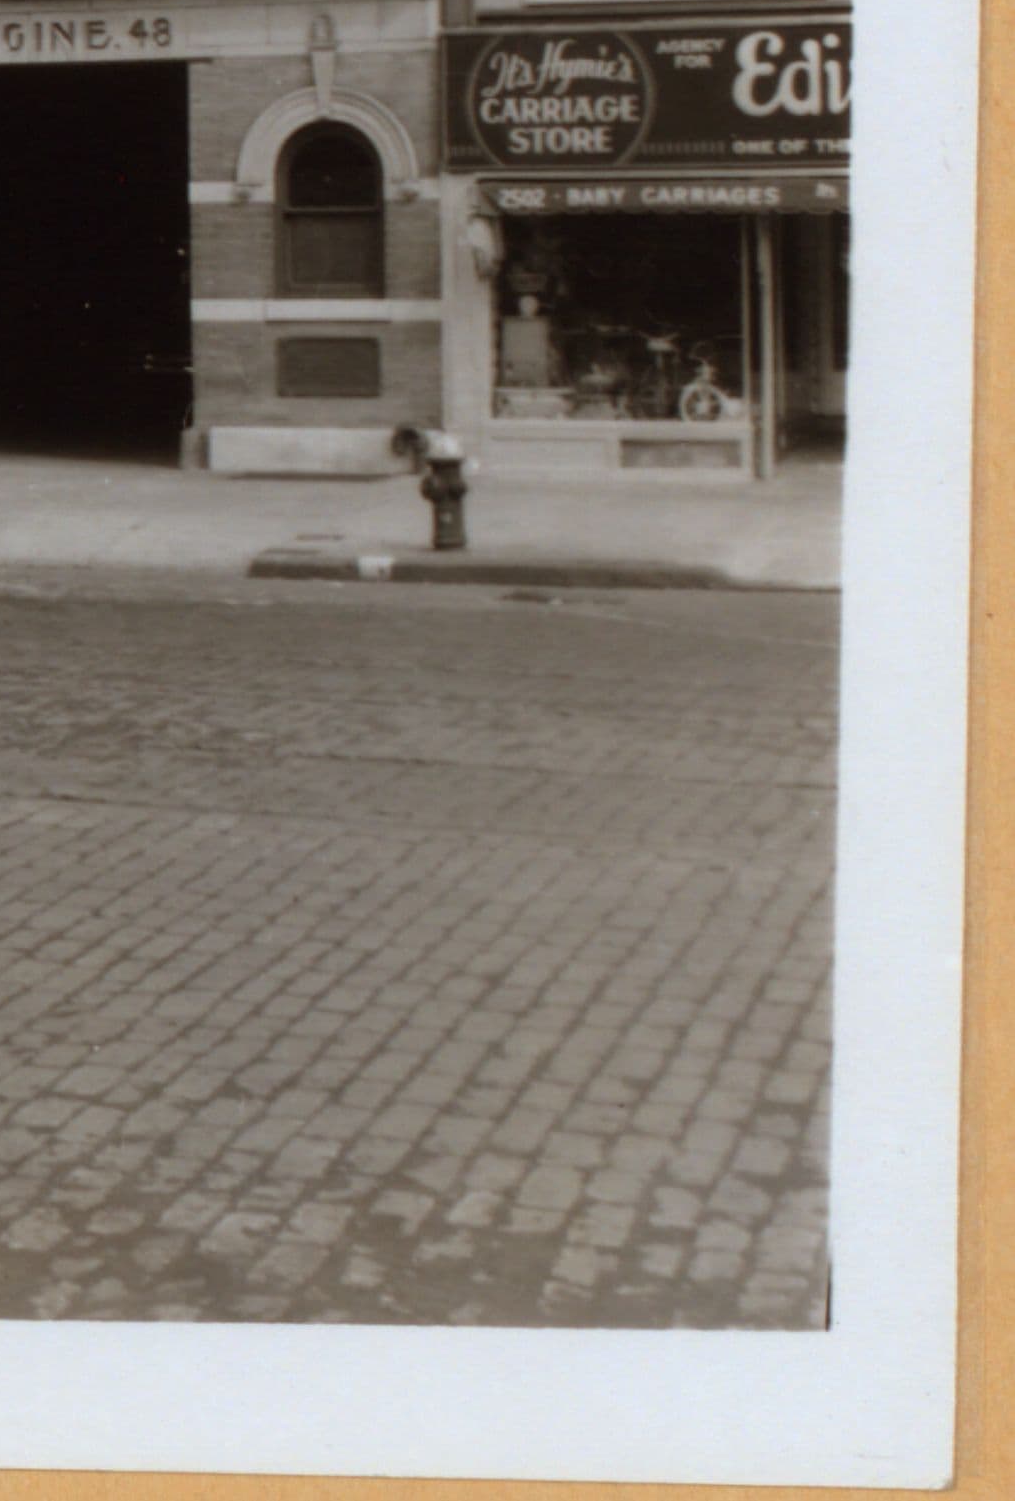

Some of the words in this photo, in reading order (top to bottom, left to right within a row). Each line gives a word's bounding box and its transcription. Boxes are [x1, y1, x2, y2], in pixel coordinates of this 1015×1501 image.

[128, 17, 173, 49] 48
[656, 38, 726, 55] AGENCY
[674, 54, 711, 69] FOR
[480, 94, 641, 125] CARRIAGE
[507, 125, 614, 154] STORE
[733, 140, 774, 155] ONE
[779, 138, 809, 154] OF
[567, 187, 625, 206] BABY
[640, 185, 781, 206] CARRIAGES
